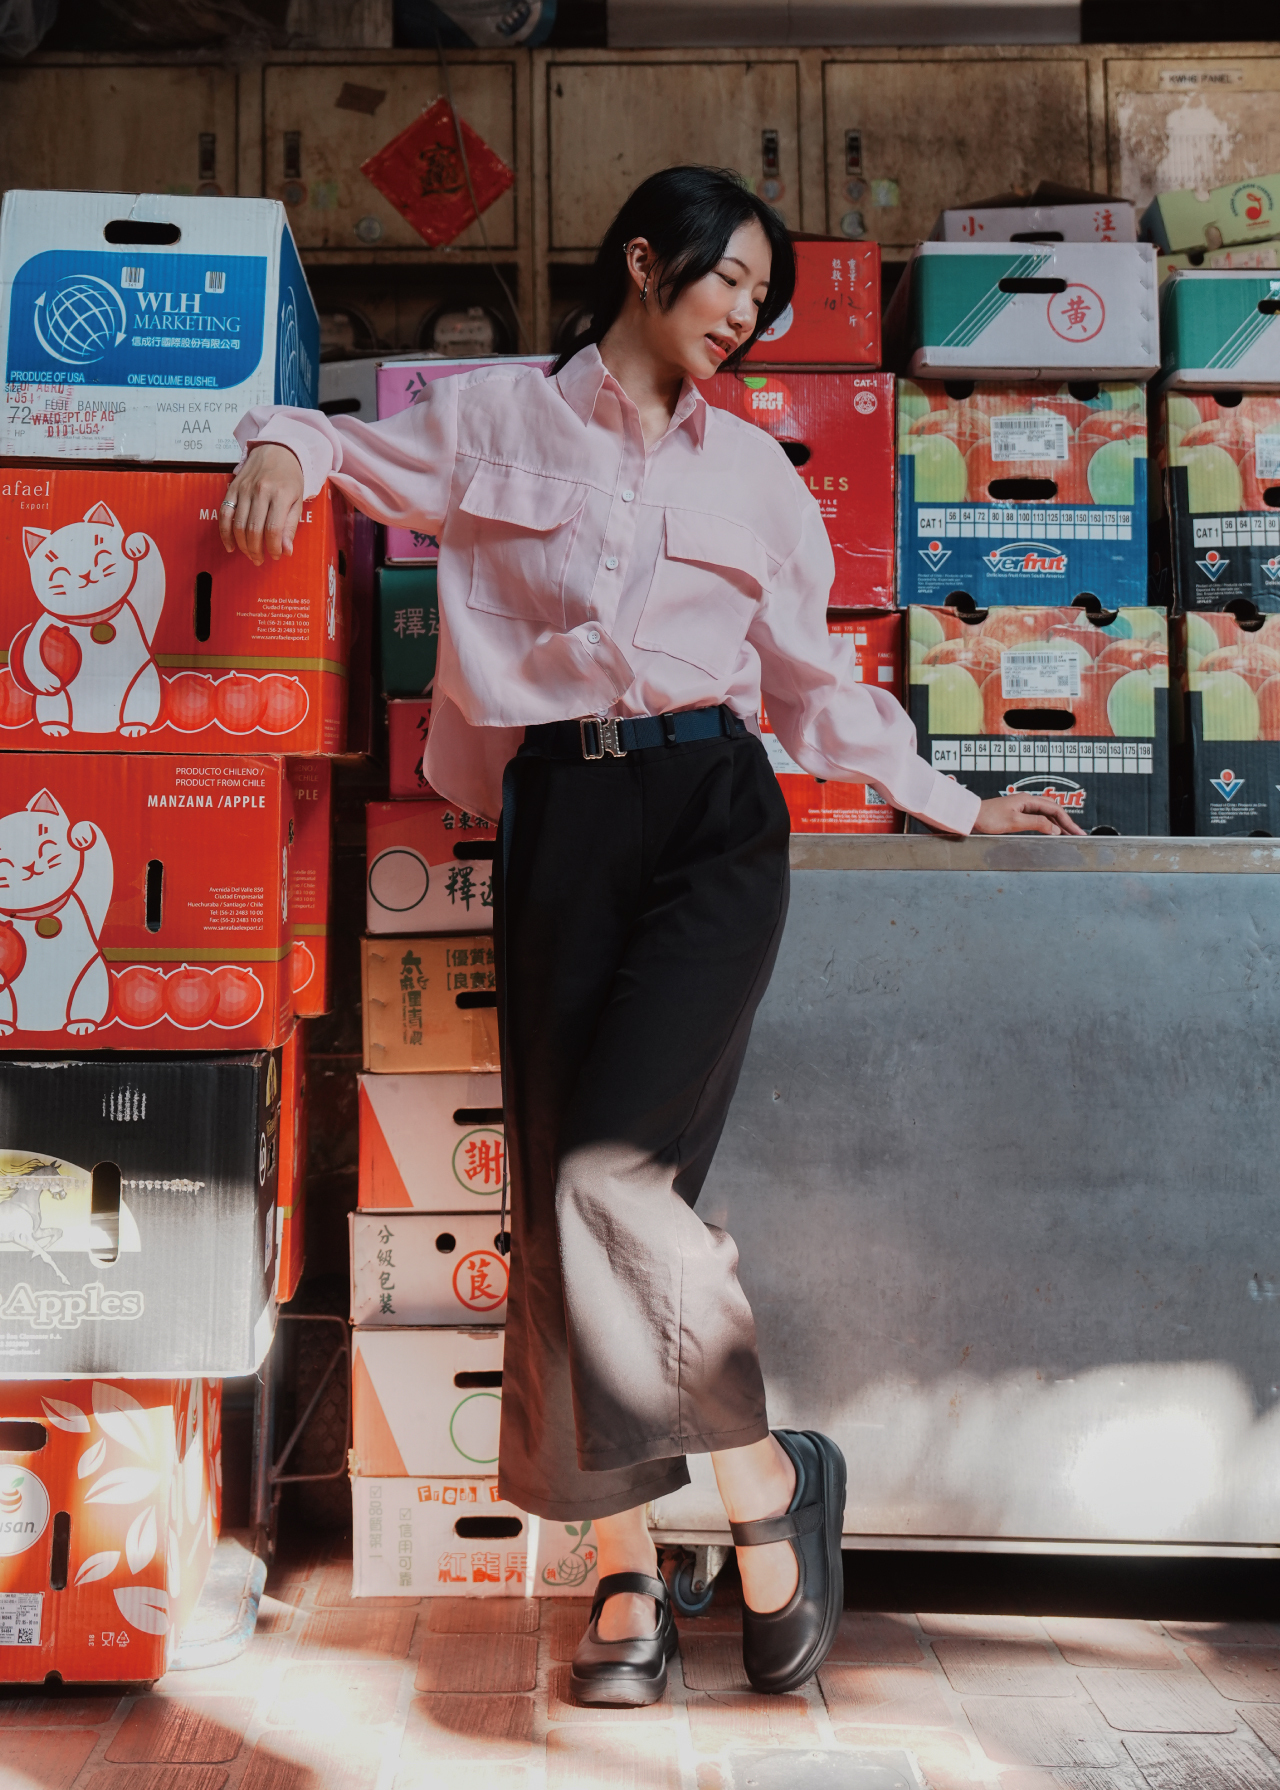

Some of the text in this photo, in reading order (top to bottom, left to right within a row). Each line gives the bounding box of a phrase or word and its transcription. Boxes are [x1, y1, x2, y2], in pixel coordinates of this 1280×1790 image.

[962, 216, 984, 238] 小
[135, 291, 202, 314] WLH
[133, 314, 241, 333] MARKETING
[10, 371, 86, 383] PRODUCE OF USA
[127, 374, 219, 387] ONE VOLUME BUSHEL
[853, 379, 878, 388] CAT-1
[751, 391, 784, 402] COPE
[77, 401, 127, 412] BANNING
[156, 402, 238, 413] WASH EX FCY PR
[752, 401, 783, 411] FRUT
[9, 406, 32, 424] 72
[181, 420, 211, 434] AAA
[1, 480, 50, 497] afael
[20, 501, 49, 511] Export
[199, 508, 219, 520] MA
[977, 513, 985, 521] 72
[1033, 514, 1044, 522] 113
[1104, 515, 1115, 523] 175
[920, 519, 942, 529] CAT 1
[1254, 519, 1262, 528] 72
[1196, 527, 1219, 539] CAT 1
[934, 750, 957, 761] CAT 1
[964, 744, 972, 752] 56
[979, 744, 986, 752] 64
[993, 744, 1002, 752] 72
[1023, 745, 1031, 753] 88
[1036, 745, 1047, 753] 100
[1051, 745, 1062, 753] 113
[1065, 745, 1077, 754] 125
[1080, 746, 1091, 754] 138
[1124, 746, 1136, 754] 175
[1139, 746, 1150, 755] 198
[175, 767, 259, 776] PRODUCTO CHILENO
[175, 778, 266, 787] PRODUCT FROM CHILE
[298, 789, 319, 800] PLE
[147, 794, 214, 808] MANZANA
[441, 809, 491, 831] 台東特
[223, 901, 246, 909] Santiago
[464, 1139, 505, 1186] 謝
[376, 1224, 397, 1315] 分級包裝
[2, 1283, 143, 1327] Apples
[417, 1485, 478, 1506] Fresh
[0, 1521, 38, 1534] san.
[437, 1551, 534, 1583] 紅龍果
